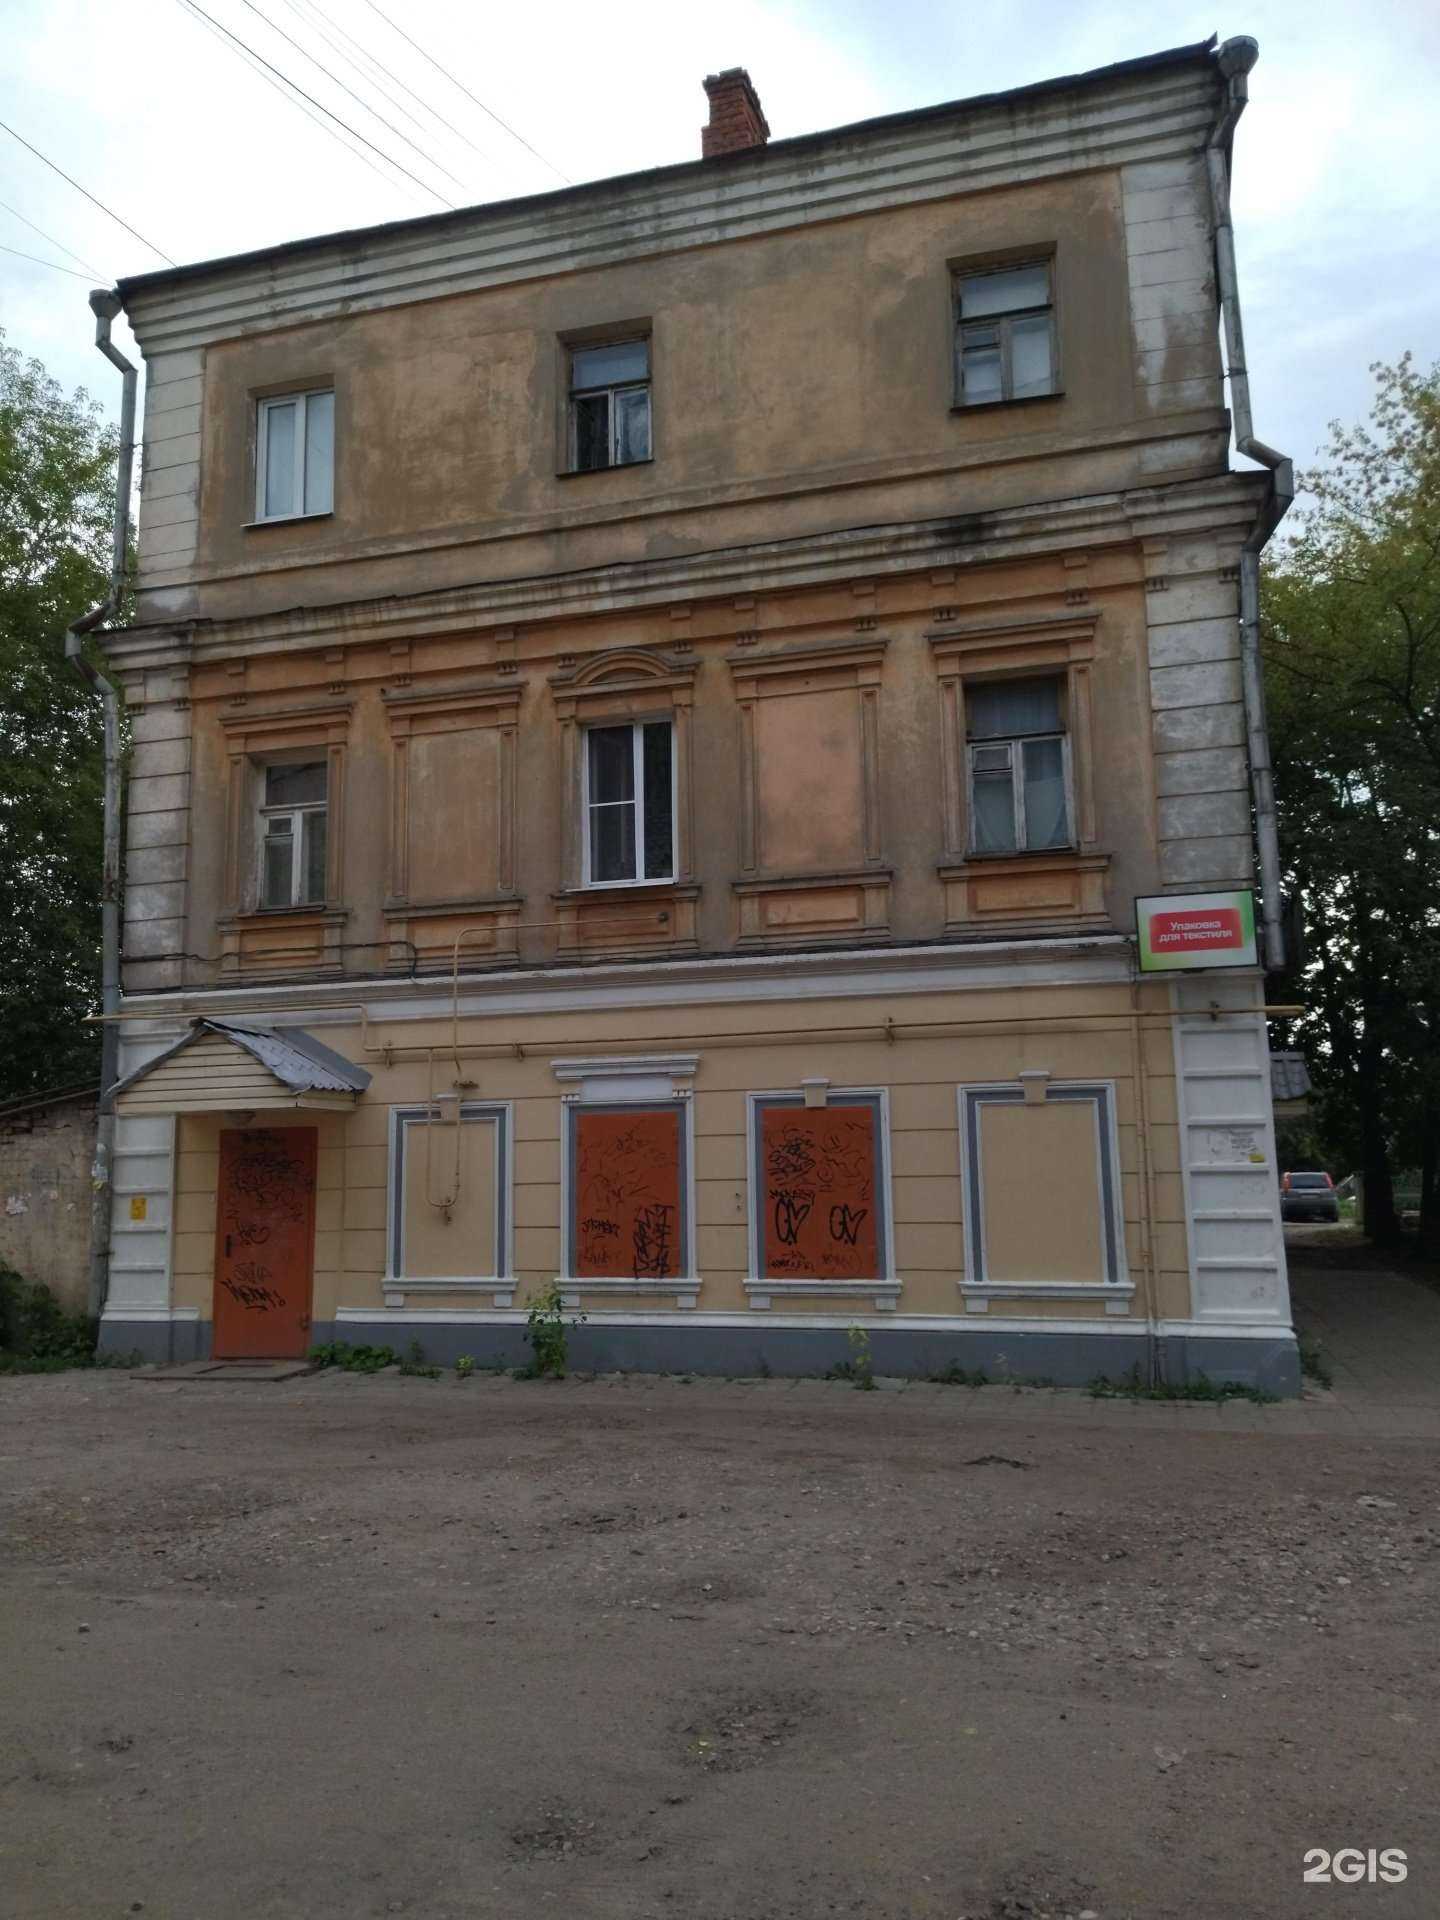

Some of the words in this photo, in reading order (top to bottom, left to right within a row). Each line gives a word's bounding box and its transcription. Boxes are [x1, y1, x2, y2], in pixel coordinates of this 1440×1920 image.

[1170, 920, 1222, 931] Упаковка
[1159, 933, 1181, 943] для
[1183, 930, 1233, 940] текстиля
